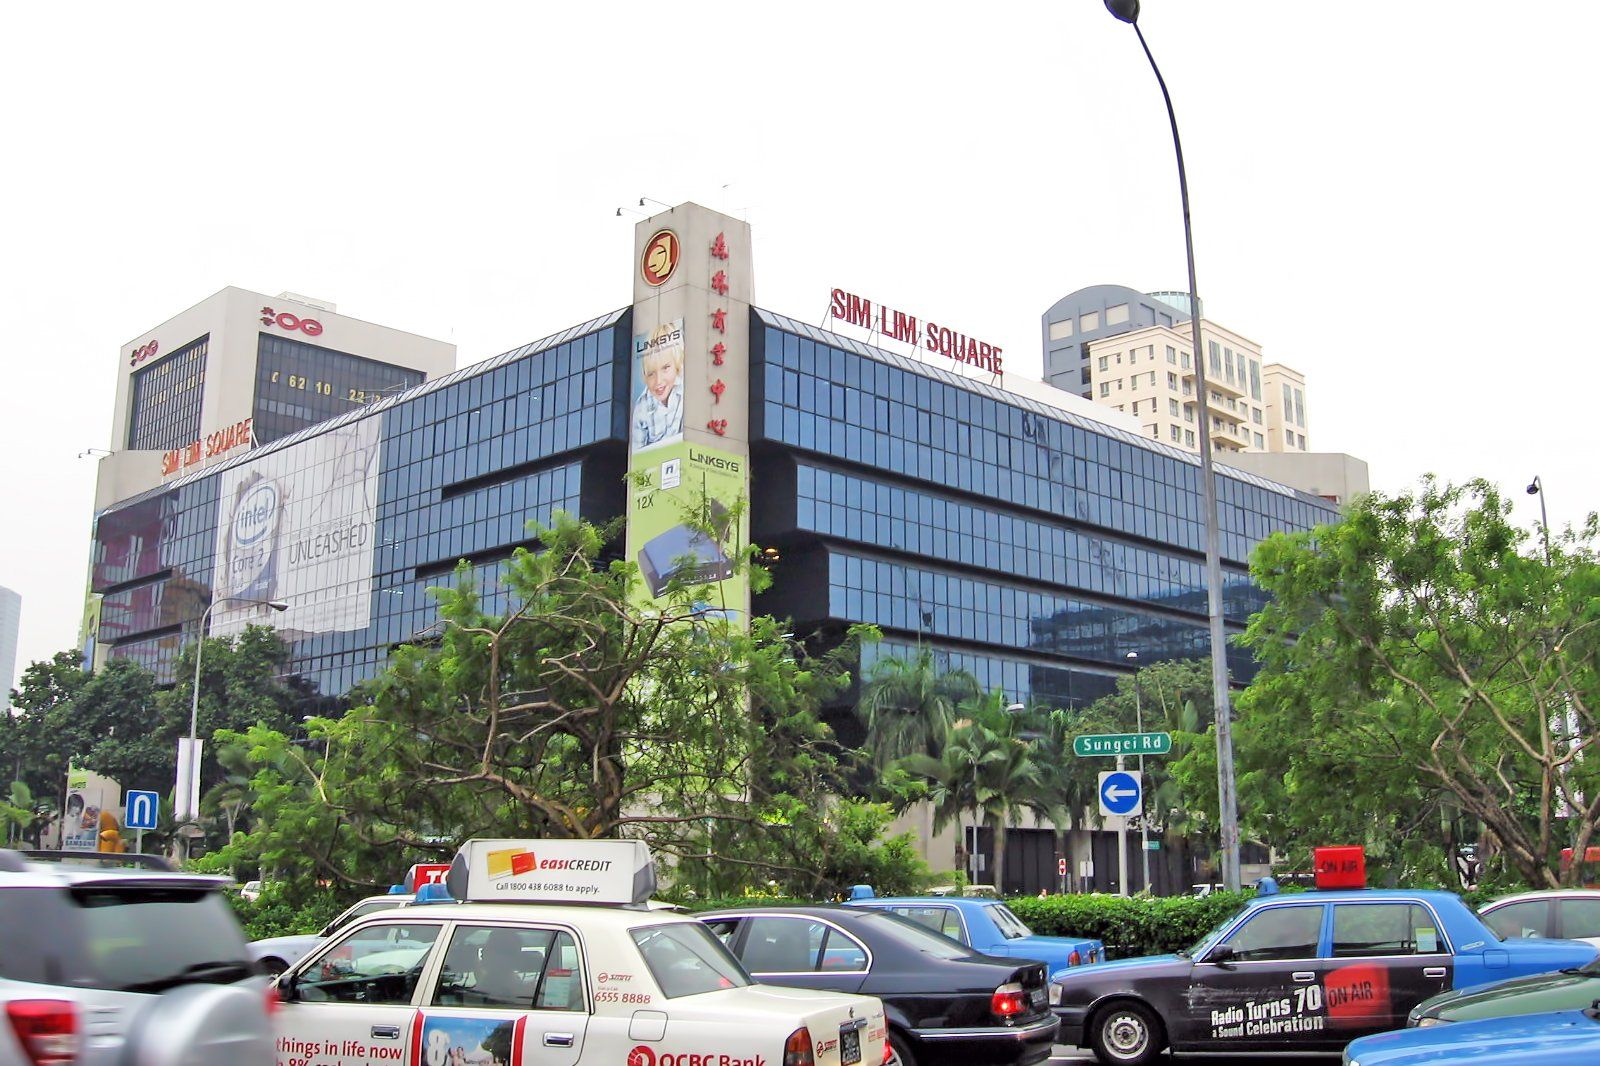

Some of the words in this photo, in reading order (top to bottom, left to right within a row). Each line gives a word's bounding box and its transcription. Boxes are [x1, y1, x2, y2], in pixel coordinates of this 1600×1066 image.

[831, 288, 871, 329] SIM
[881, 305, 917, 345] LIM
[926, 322, 1003, 375] SQUARE
[205, 417, 253, 458] SQUARE
[240, 497, 270, 529] intel
[636, 493, 655, 511] 12X
[289, 522, 368, 565] UNLEASHED
[1083, 736, 1137, 753] Sungei
[1142, 735, 1161, 749] Rd
[496, 882, 509, 891] Call
[509, 882, 527, 891] 1800
[528, 883, 542, 892] 438
[576, 884, 600, 895] apply.
[594, 991, 619, 1003] 6555
[621, 992, 651, 1004] 8888
[1211, 1006, 1244, 1026] Radio
[1246, 998, 1291, 1021] Turns
[1294, 984, 1322, 1013] 70
[1328, 988, 1348, 1008] ON
[1351, 981, 1373, 1000] AIR
[1212, 1029, 1217, 1038] a
[1218, 1023, 1244, 1038] Sound
[1246, 1014, 1324, 1036] Celebration
[324, 1040, 338, 1055] in
[342, 1040, 365, 1057] life
[369, 1046, 403, 1060] now
[659, 1054, 714, 1066] OCBC
[719, 1054, 766, 1066] Bank
